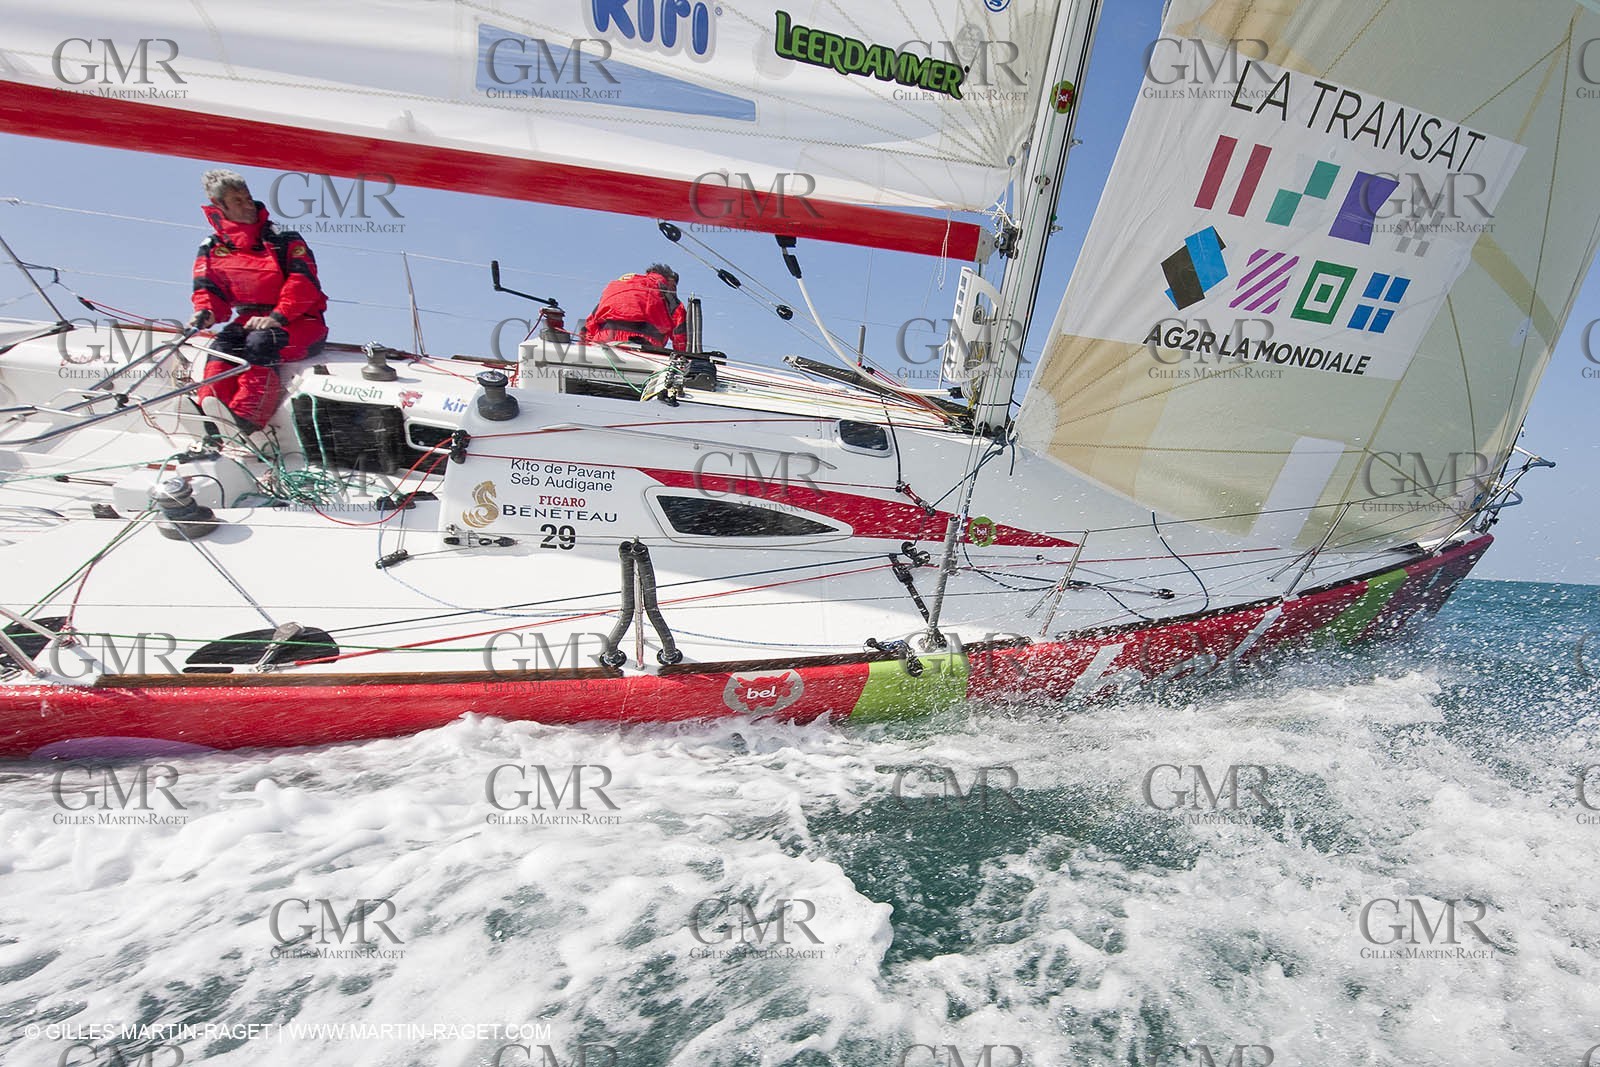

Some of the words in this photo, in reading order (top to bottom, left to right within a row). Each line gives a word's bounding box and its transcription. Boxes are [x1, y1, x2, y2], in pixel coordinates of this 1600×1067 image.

[775, 10, 963, 100] LEERDAMMER
[1231, 60, 1290, 121] LA
[1307, 80, 1486, 172] TRANSAT
[1143, 324, 1217, 354] AG2R
[1218, 335, 1250, 359] LA
[1254, 340, 1372, 375] MONDIALE
[322, 379, 383, 401] boursin
[511, 458, 540, 473] Kito
[544, 462, 562, 475] de
[568, 464, 615, 480] Pavant
[544, 475, 613, 492] Audigane
[539, 495, 586, 508] FIGARO
[540, 524, 576, 551] 29
[747, 685, 776, 699] bel
